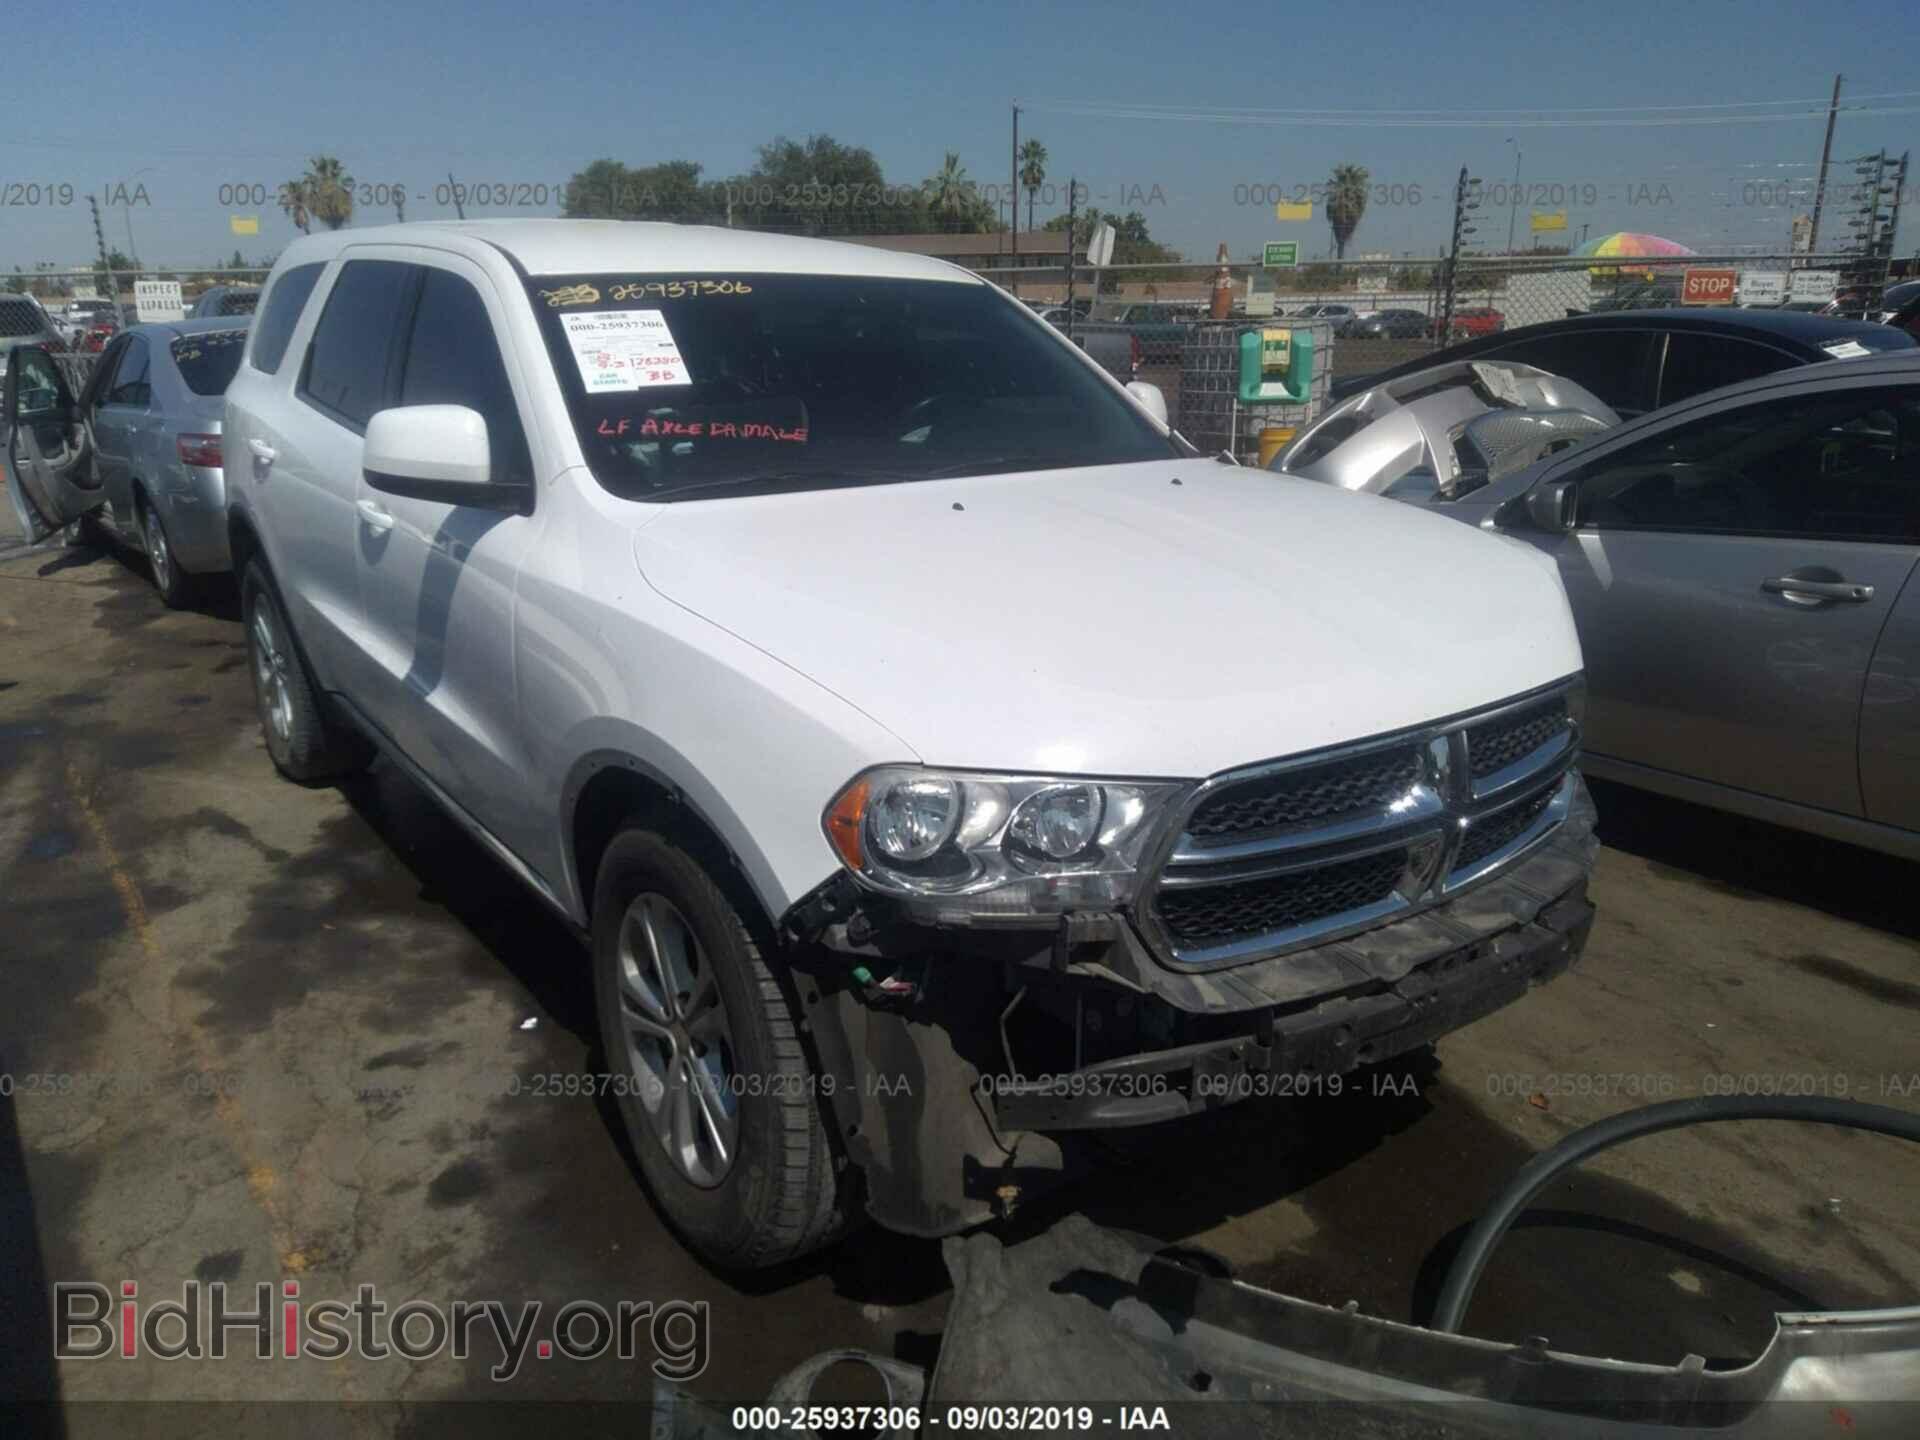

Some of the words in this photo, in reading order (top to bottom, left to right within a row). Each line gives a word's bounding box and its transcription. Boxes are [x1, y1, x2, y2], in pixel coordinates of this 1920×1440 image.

[138, 284, 178, 295] INSPECT
[608, 280, 753, 300] 25937306
[1689, 277, 1730, 294] STOP
[569, 320, 664, 332] 000-25937306
[598, 418, 632, 435] LF
[641, 418, 704, 436] AXLE
